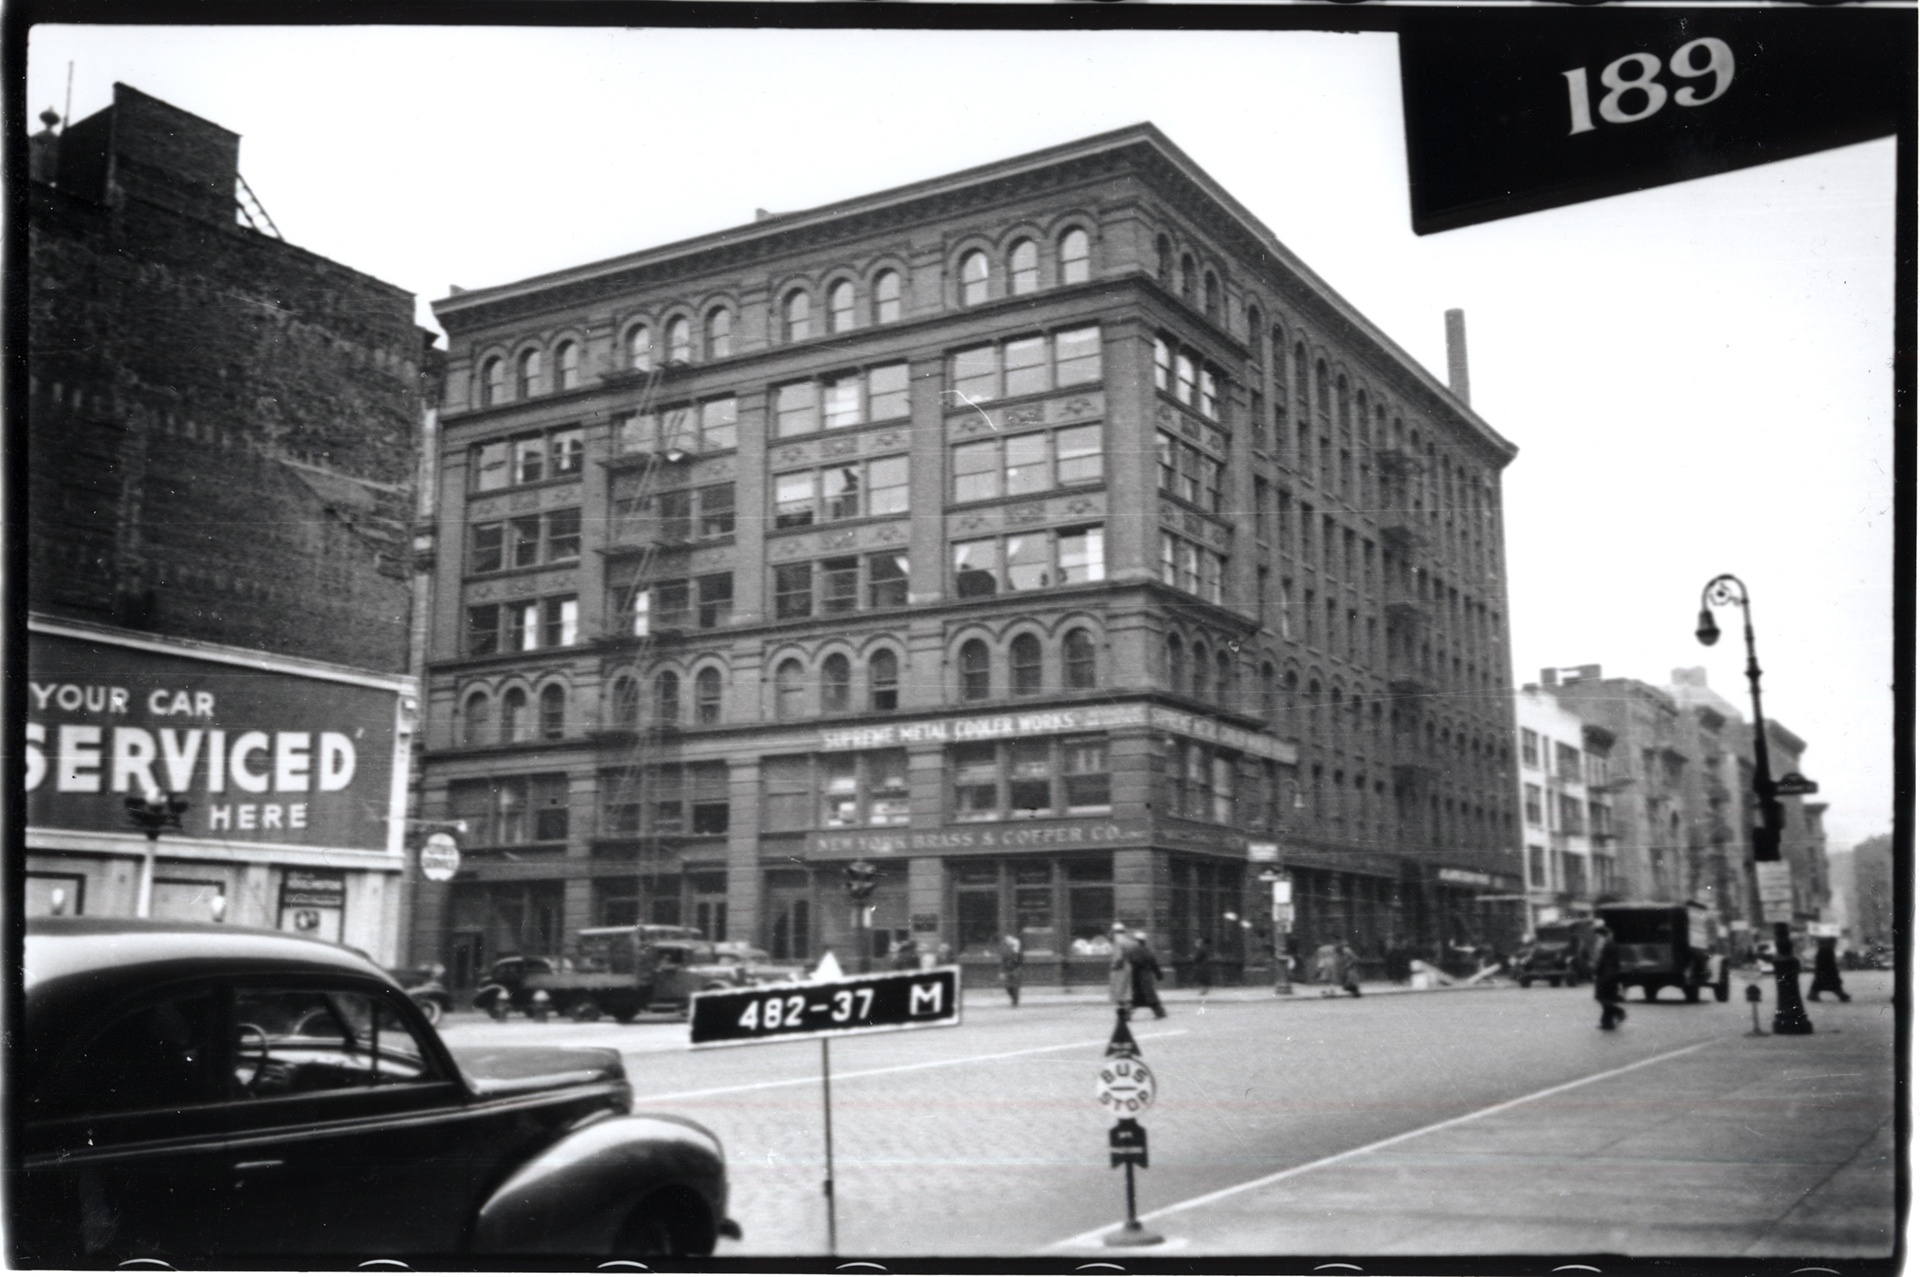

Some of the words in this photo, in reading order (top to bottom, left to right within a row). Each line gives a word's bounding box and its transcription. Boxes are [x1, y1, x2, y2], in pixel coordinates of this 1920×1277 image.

[1561, 37, 1736, 136] 189
[29, 683, 129, 714] YOUR
[148, 689, 215, 717] CAR
[900, 722, 946, 742] METAL
[1018, 711, 1074, 732] WORKS
[209, 803, 308, 830] HERE
[912, 832, 973, 849] BRASS
[981, 832, 994, 846] &
[739, 989, 874, 1030] 482-37
[910, 982, 942, 1016] M
[1100, 1063, 1147, 1085] BUS
[1100, 1090, 1149, 1112] STOP
